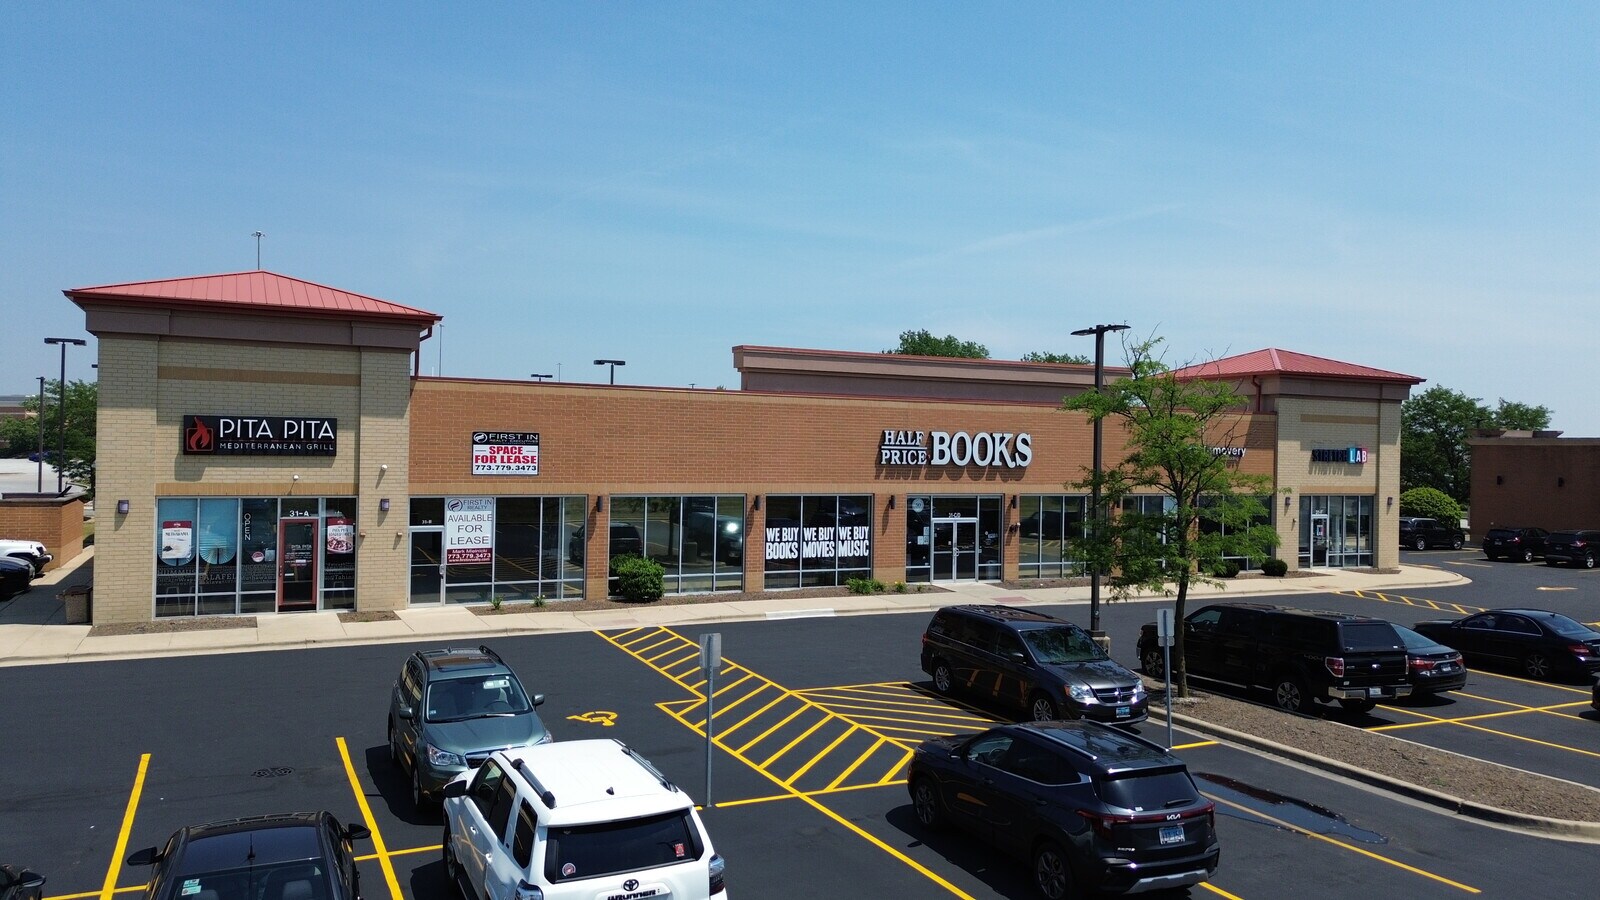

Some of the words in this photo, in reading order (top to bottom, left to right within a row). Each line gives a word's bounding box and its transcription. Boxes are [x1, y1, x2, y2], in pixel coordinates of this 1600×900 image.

[220, 419, 272, 438] PITA
[284, 420, 334, 439] PITA
[884, 430, 924, 445] HALF
[489, 446, 523, 454] SPACE
[931, 432, 1032, 468] BOOKS
[1348, 449, 1367, 463] LAB
[475, 455, 497, 464] FOR
[500, 455, 536, 464] LEASE
[881, 450, 927, 465] PRICE
[448, 514, 492, 522] AVAILABLE
[458, 525, 482, 533] FOR
[766, 528, 780, 541] WE
[782, 528, 799, 541] BUY
[804, 528, 816, 540] WE
[819, 527, 834, 540] BUY
[839, 527, 852, 540] WE
[854, 526, 869, 540] BUY
[451, 536, 489, 545] LEASE
[766, 542, 798, 559] BOOKS
[803, 541, 834, 558] MOVIES
[839, 540, 869, 557] MUSIC
